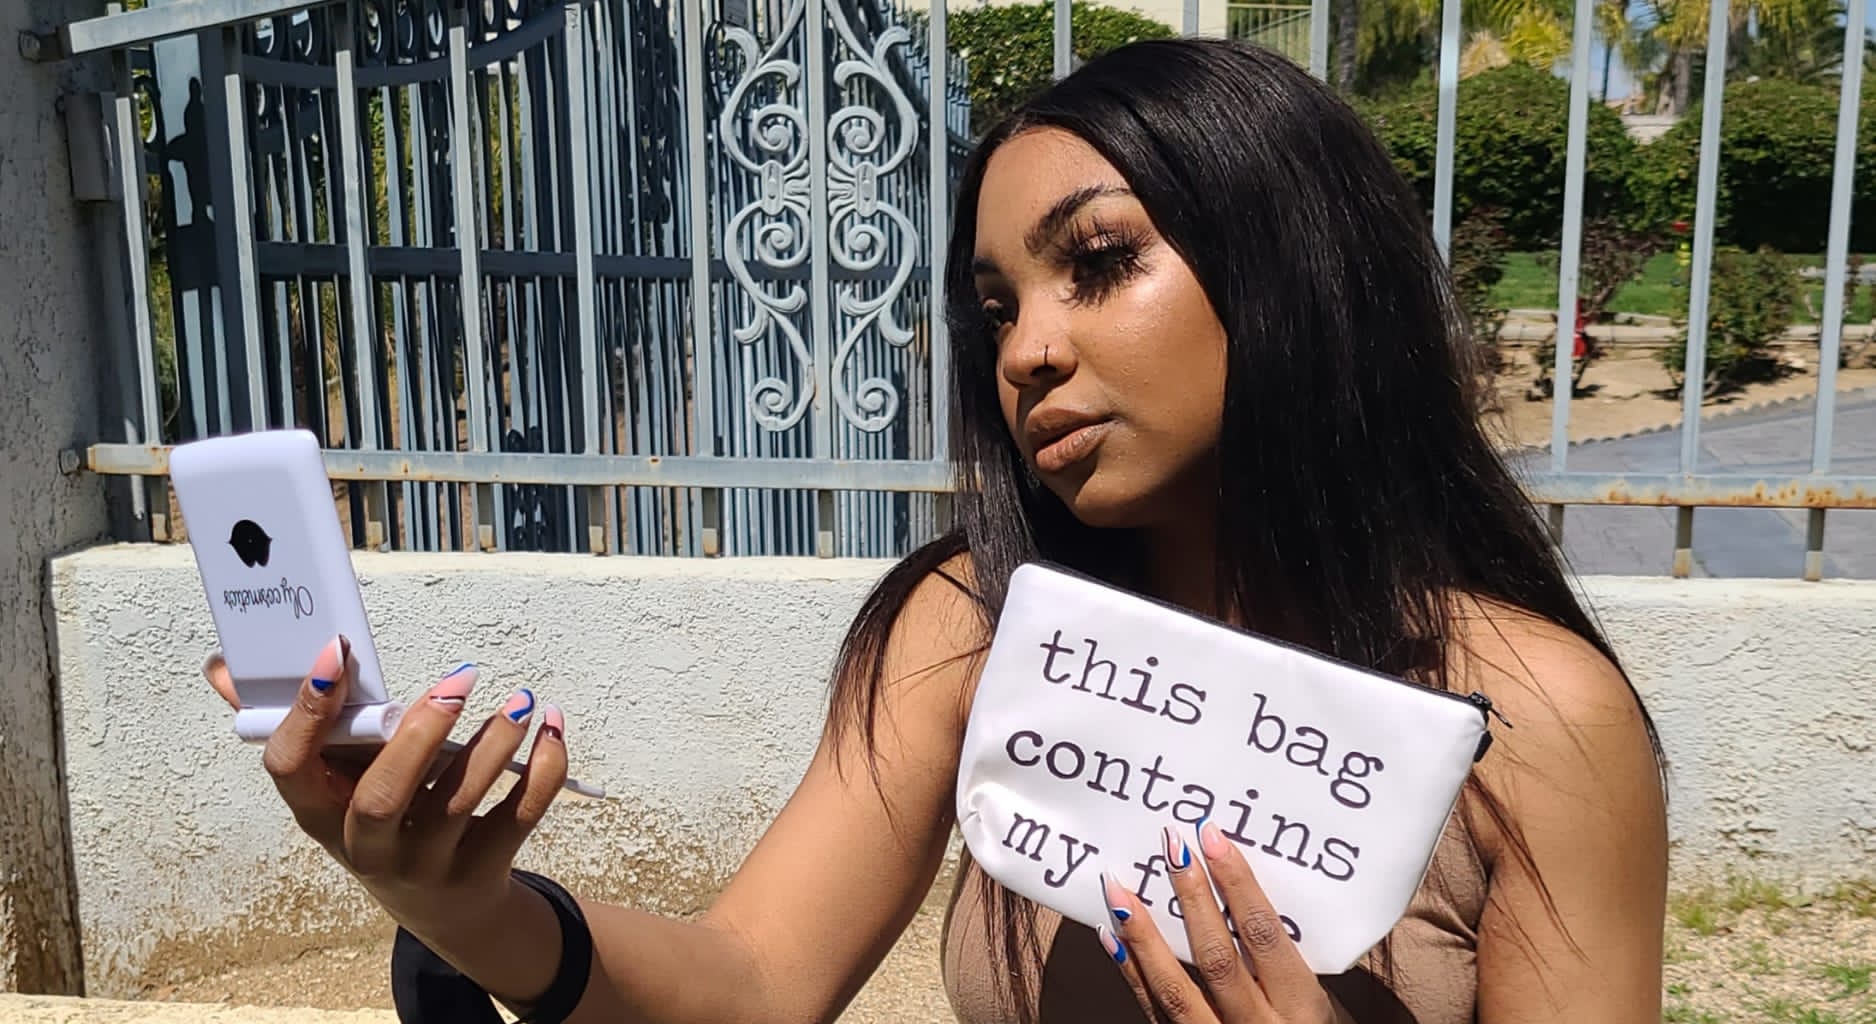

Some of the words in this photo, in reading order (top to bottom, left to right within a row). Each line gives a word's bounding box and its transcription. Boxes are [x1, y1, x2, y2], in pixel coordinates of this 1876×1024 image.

[1040, 630, 1207, 725] this
[1247, 694, 1384, 808] bag
[1002, 812, 1099, 888] my
[1005, 729, 1361, 882] contains
